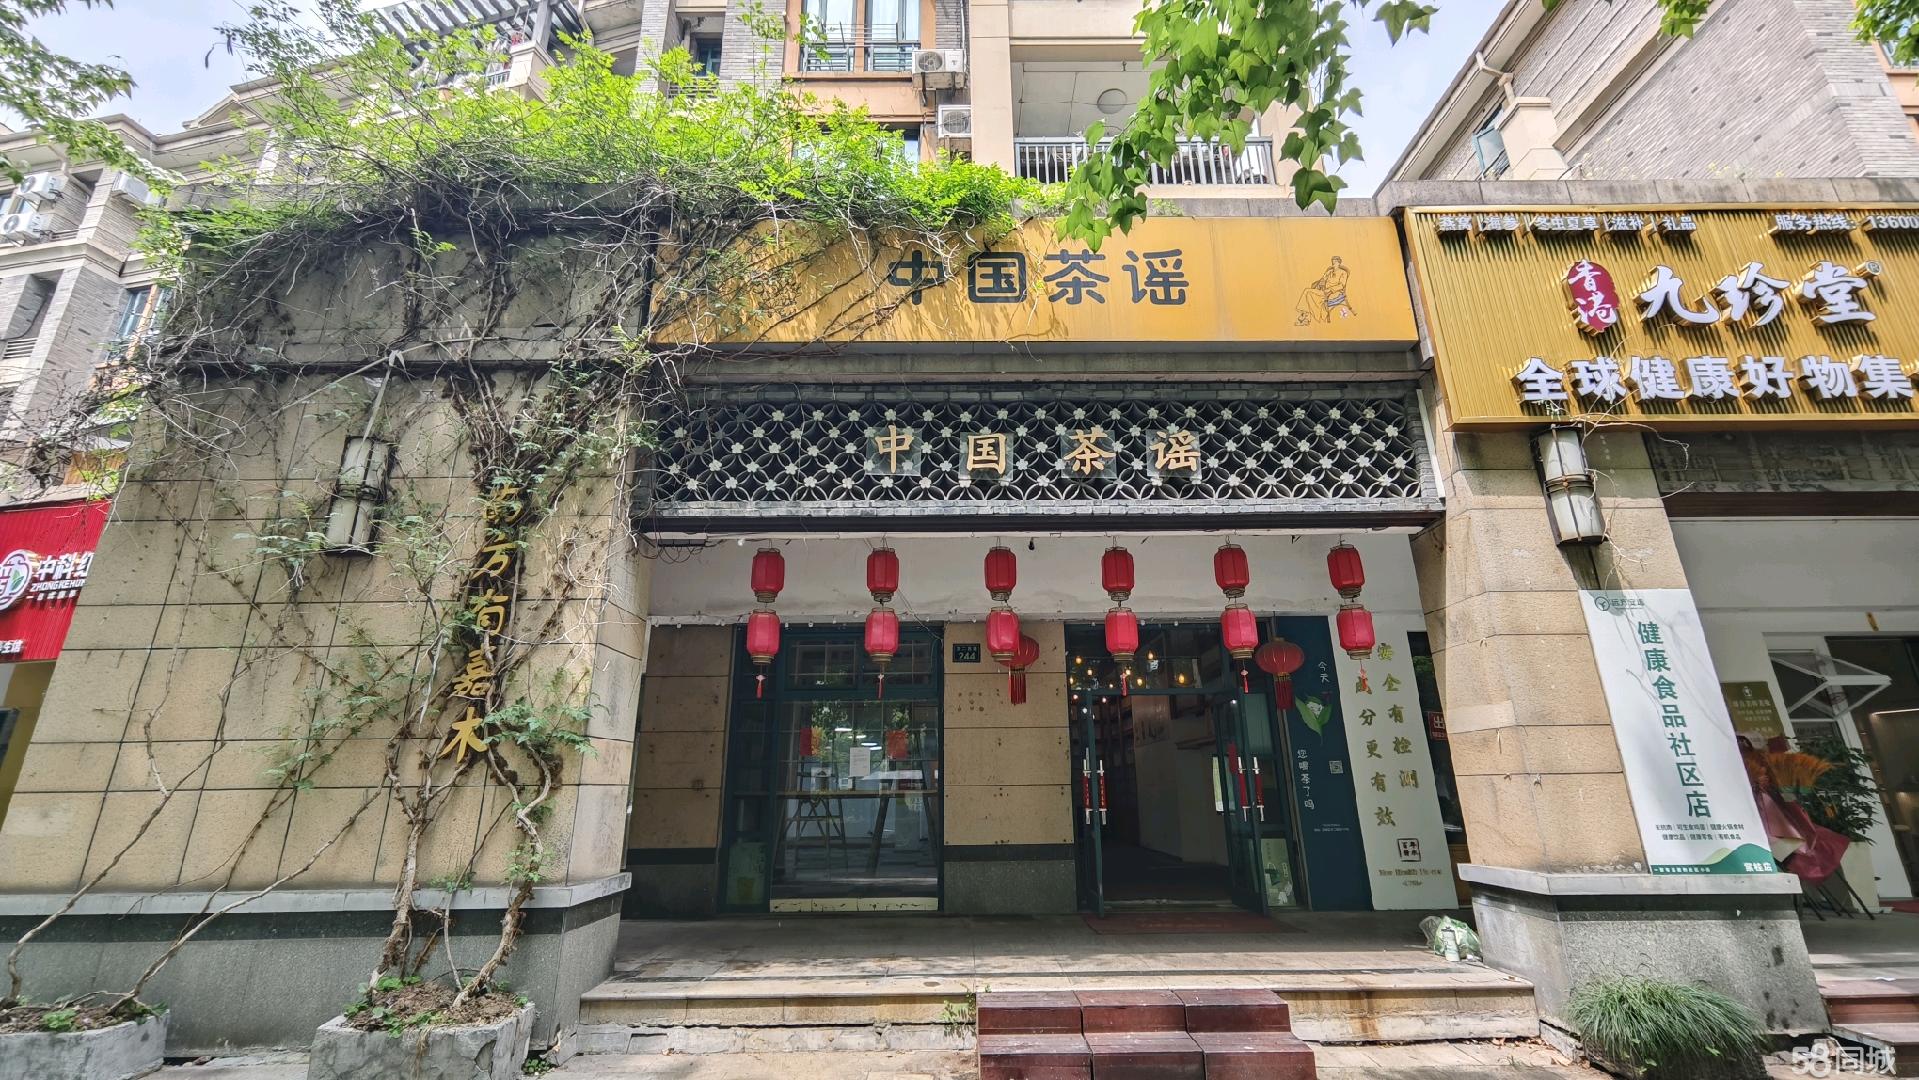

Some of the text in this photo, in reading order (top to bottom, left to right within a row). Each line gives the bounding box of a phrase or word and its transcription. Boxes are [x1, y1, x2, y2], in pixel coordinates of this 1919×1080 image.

[1485, 215, 1520, 231] 海参
[1535, 215, 1599, 231] 冬虫夏草
[1612, 216, 1643, 231] 滋补
[1663, 216, 1696, 231] 礼品
[887, 248, 1190, 306] 中国茶谣
[1567, 259, 1618, 325] 香港
[1640, 260, 1876, 328] 九珍堂
[1515, 354, 1914, 401] 全球健康好物集
[874, 424, 1201, 475] 中国茶谣
[1317, 661, 1330, 683] 今天
[1637, 620, 1712, 818] 健康食品社区店
